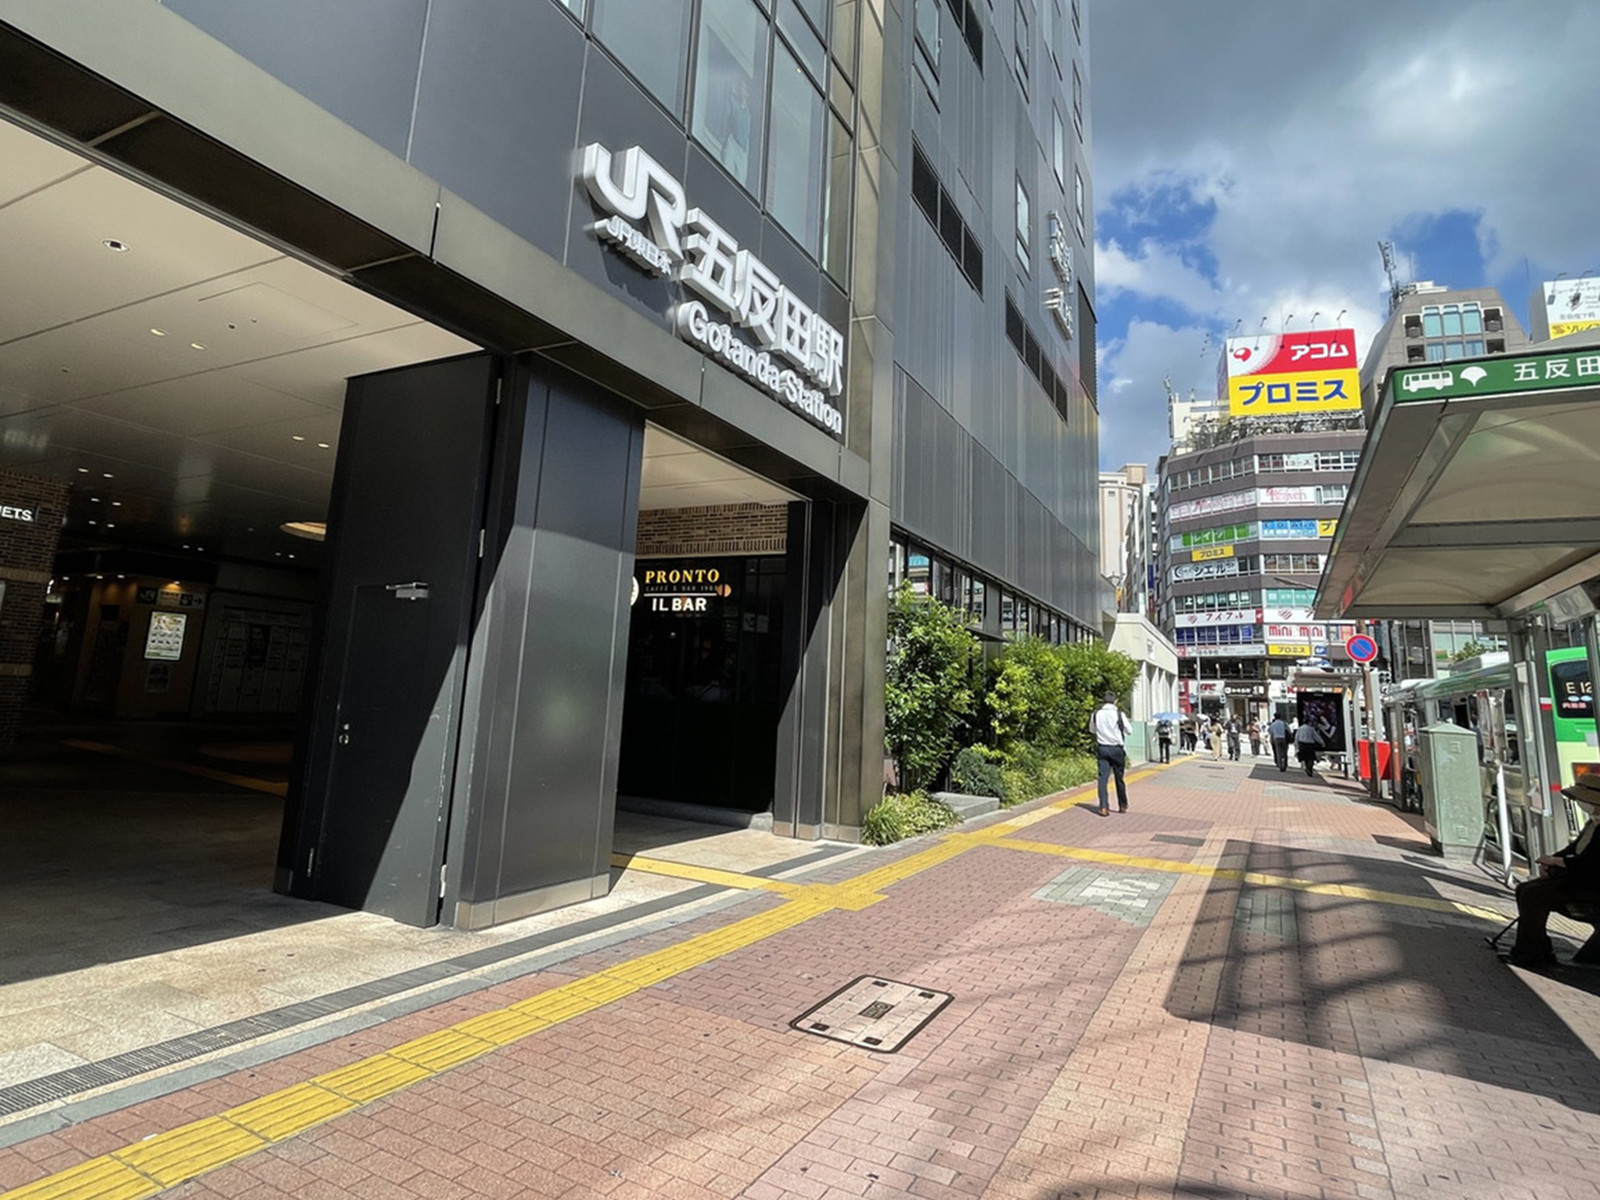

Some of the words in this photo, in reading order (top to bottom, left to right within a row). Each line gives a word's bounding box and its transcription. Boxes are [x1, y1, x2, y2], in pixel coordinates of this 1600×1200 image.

[1290, 342, 1349, 361] アコム
[676, 300, 781, 392] Gotanda
[780, 369, 842, 434] Station
[1238, 379, 1348, 406] プロミス
[0, 505, 34, 522] ETS
[645, 568, 720, 584] PRONTO
[652, 598, 668, 611] IL
[672, 597, 707, 611] BAR
[1268, 625, 1293, 637] mini
[1299, 625, 1323, 637] mini
